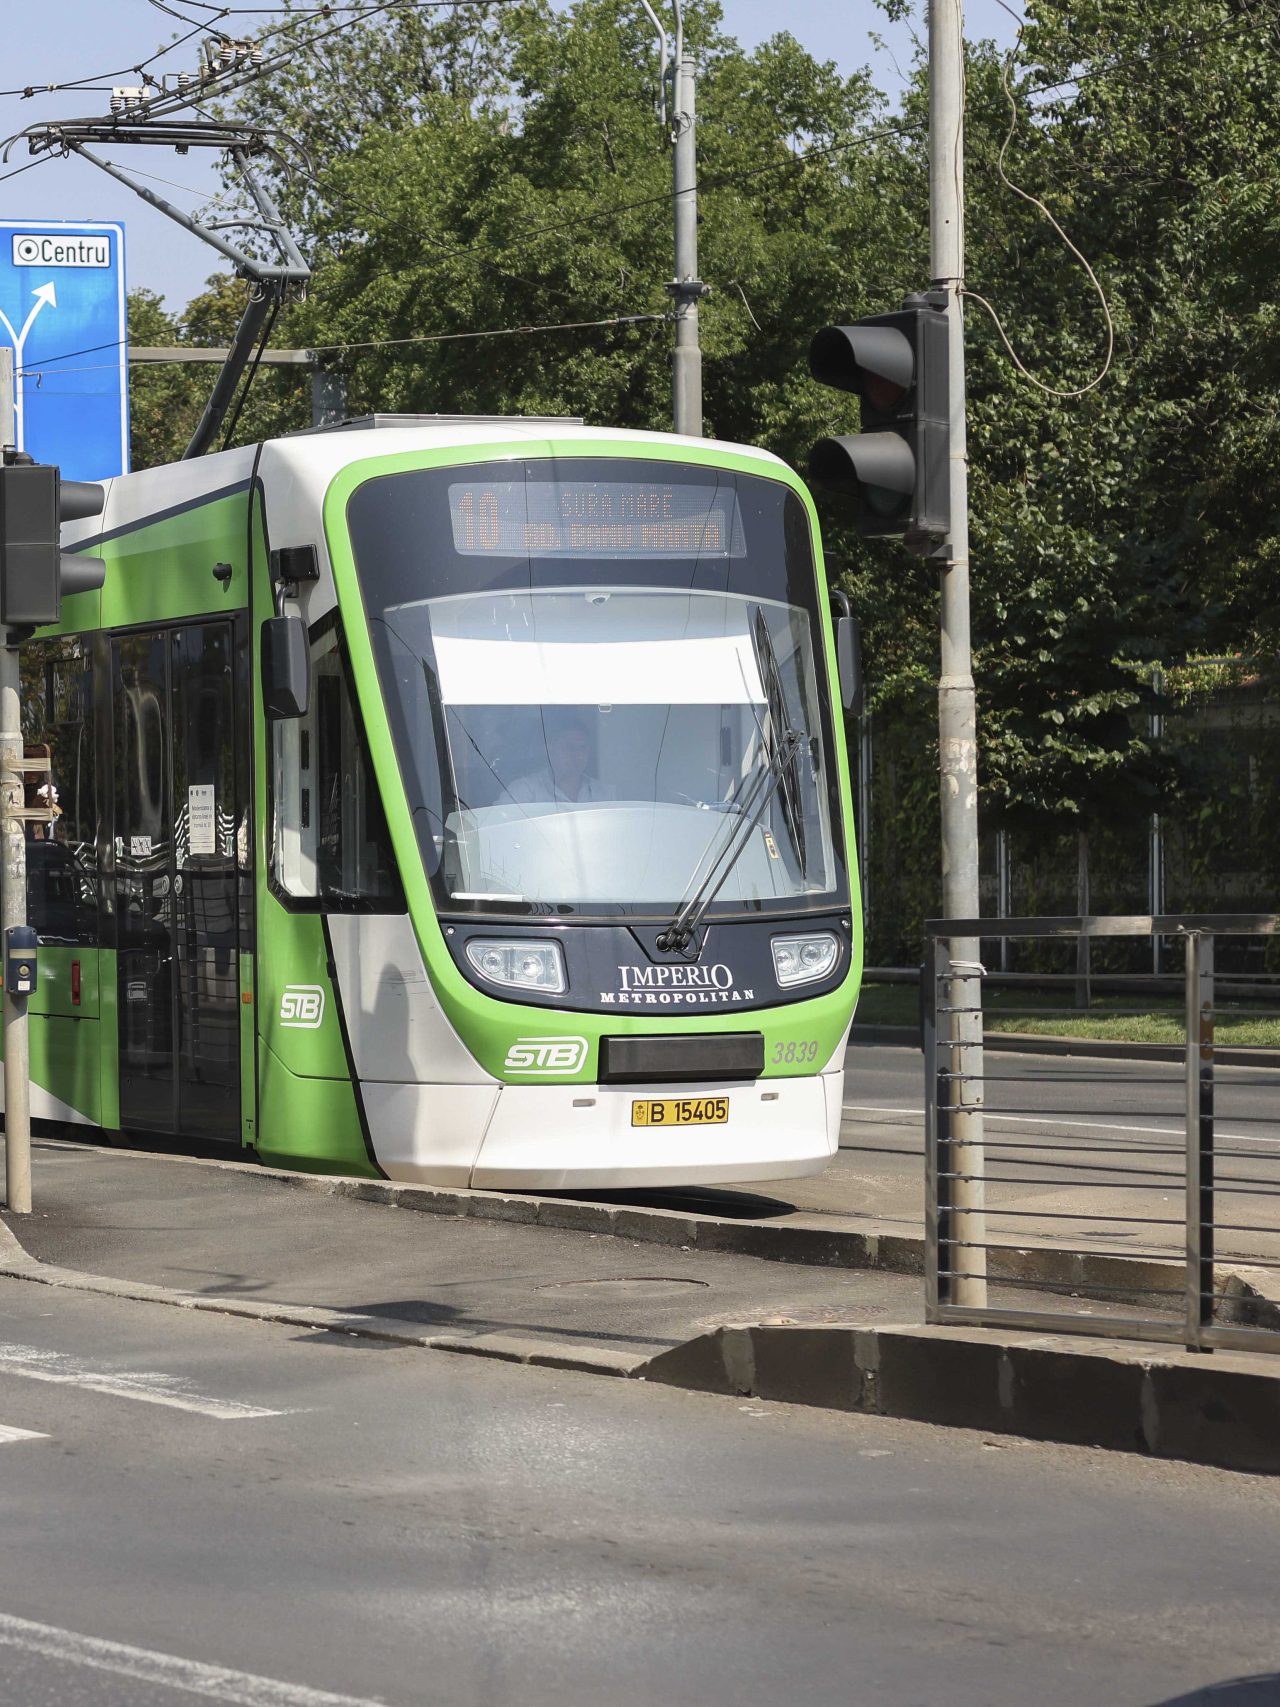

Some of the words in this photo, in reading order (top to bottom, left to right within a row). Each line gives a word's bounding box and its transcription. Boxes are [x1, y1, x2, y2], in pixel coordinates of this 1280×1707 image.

[41, 239, 106, 264] Centru
[458, 491, 500, 550] 10
[617, 963, 733, 992] IMPERIO
[280, 992, 319, 1020] STB
[600, 988, 755, 1005] METROPOLITAN
[504, 1043, 581, 1068] STB
[771, 1040, 819, 1065] 3839
[650, 1103, 666, 1124] B
[674, 1100, 727, 1122] 15405
